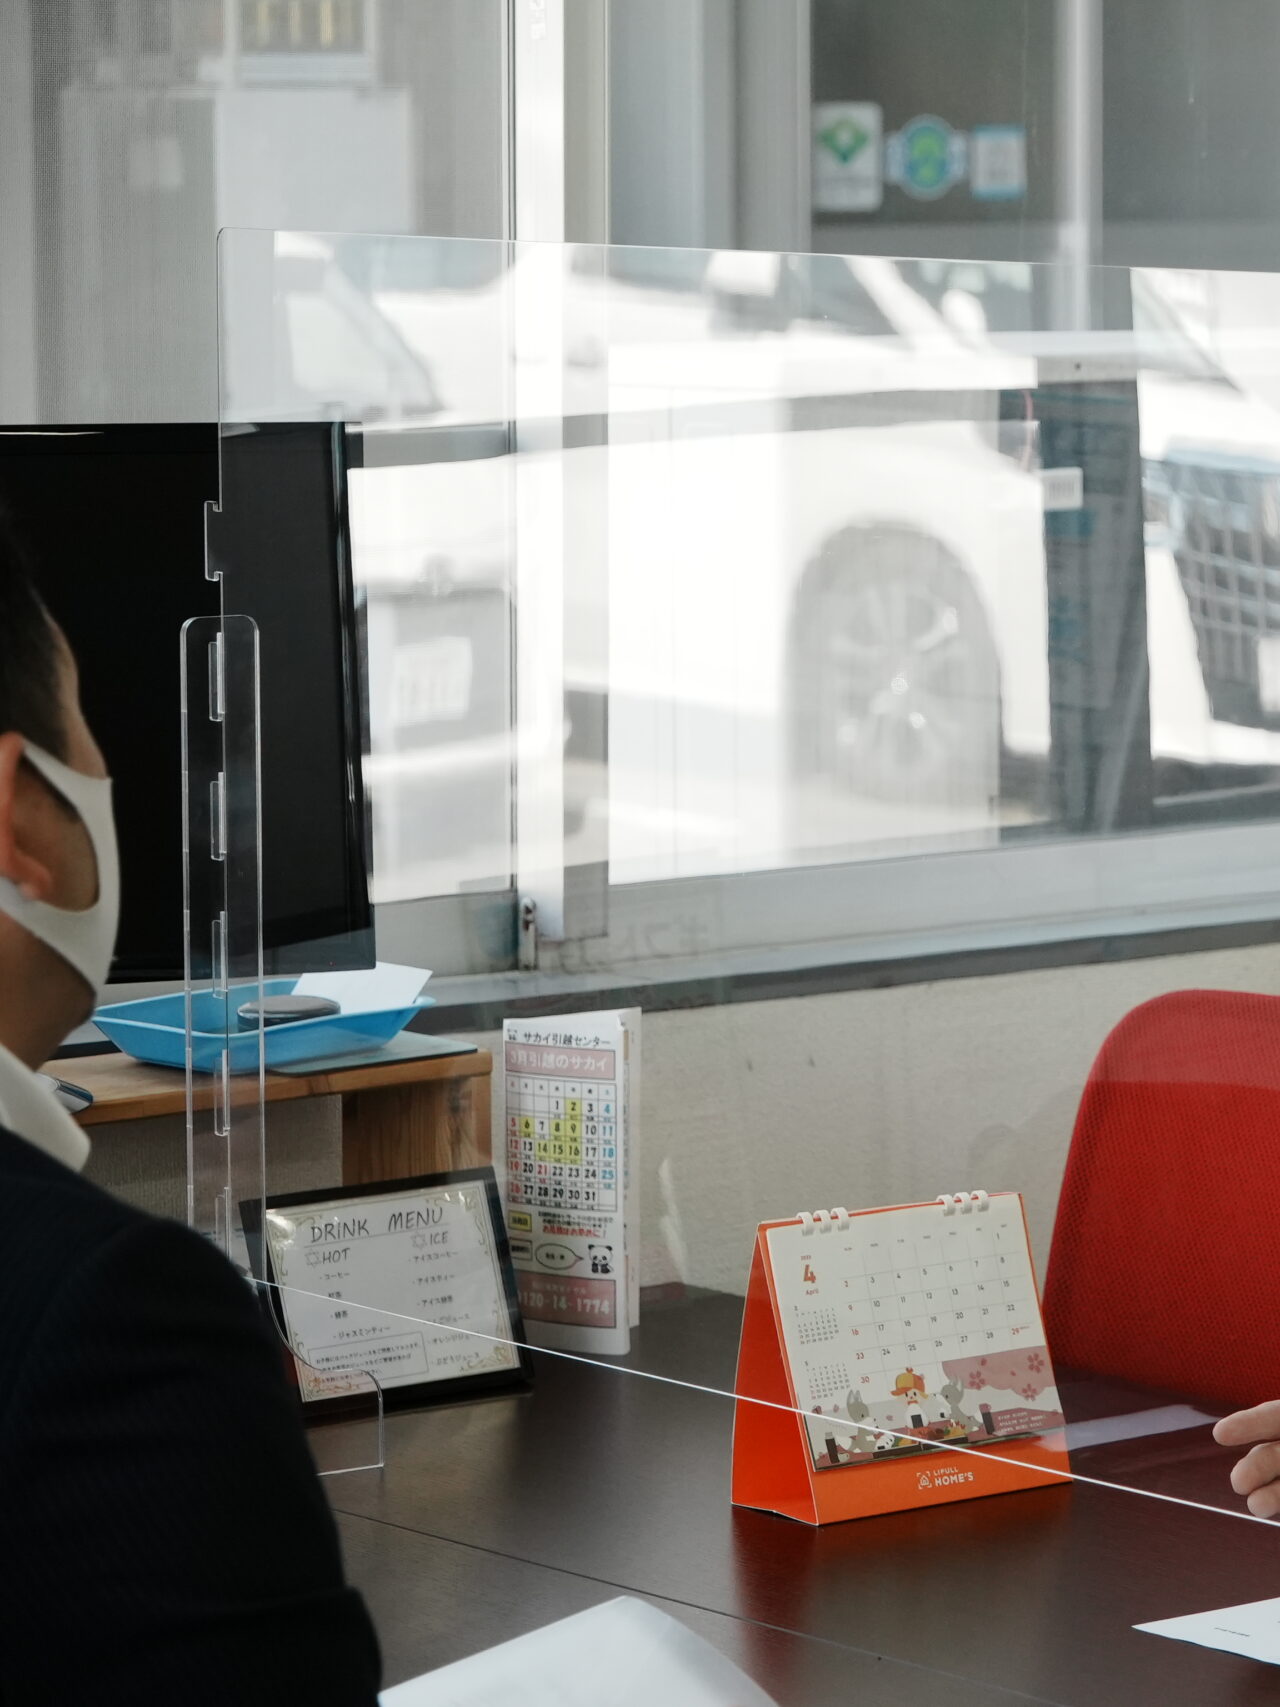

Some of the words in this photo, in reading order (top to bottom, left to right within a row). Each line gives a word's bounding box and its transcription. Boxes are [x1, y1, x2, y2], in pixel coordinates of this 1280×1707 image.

[524, 1031, 611, 1047] サカイ引越センター
[585, 1125, 597, 1135] 10
[603, 1126, 613, 1136] 11
[510, 1139, 519, 1150] 12
[523, 1141, 533, 1151] 13
[538, 1142, 548, 1153] 14
[553, 1144, 563, 1155] 15
[569, 1145, 580, 1156] 16
[585, 1147, 597, 1157] 17
[603, 1147, 614, 1158] 18
[523, 1162, 533, 1174] 20
[538, 1164, 548, 1175] 21
[552, 1166, 563, 1176] 22
[568, 1168, 579, 1178] 23
[584, 1169, 597, 1179] 24
[601, 1169, 614, 1180] 25
[523, 1184, 534, 1195] 27
[538, 1186, 549, 1197] 28
[552, 1188, 564, 1199] 29
[568, 1190, 580, 1200] 30
[584, 1191, 596, 1202] 31
[311, 1217, 370, 1244] DRINK
[388, 1206, 443, 1232] MENU
[430, 1231, 448, 1245] ICE
[322, 1247, 351, 1264] HOT
[803, 1264, 816, 1284] 4
[805, 1288, 819, 1296] April
[934, 1471, 974, 1487] HOME'S
